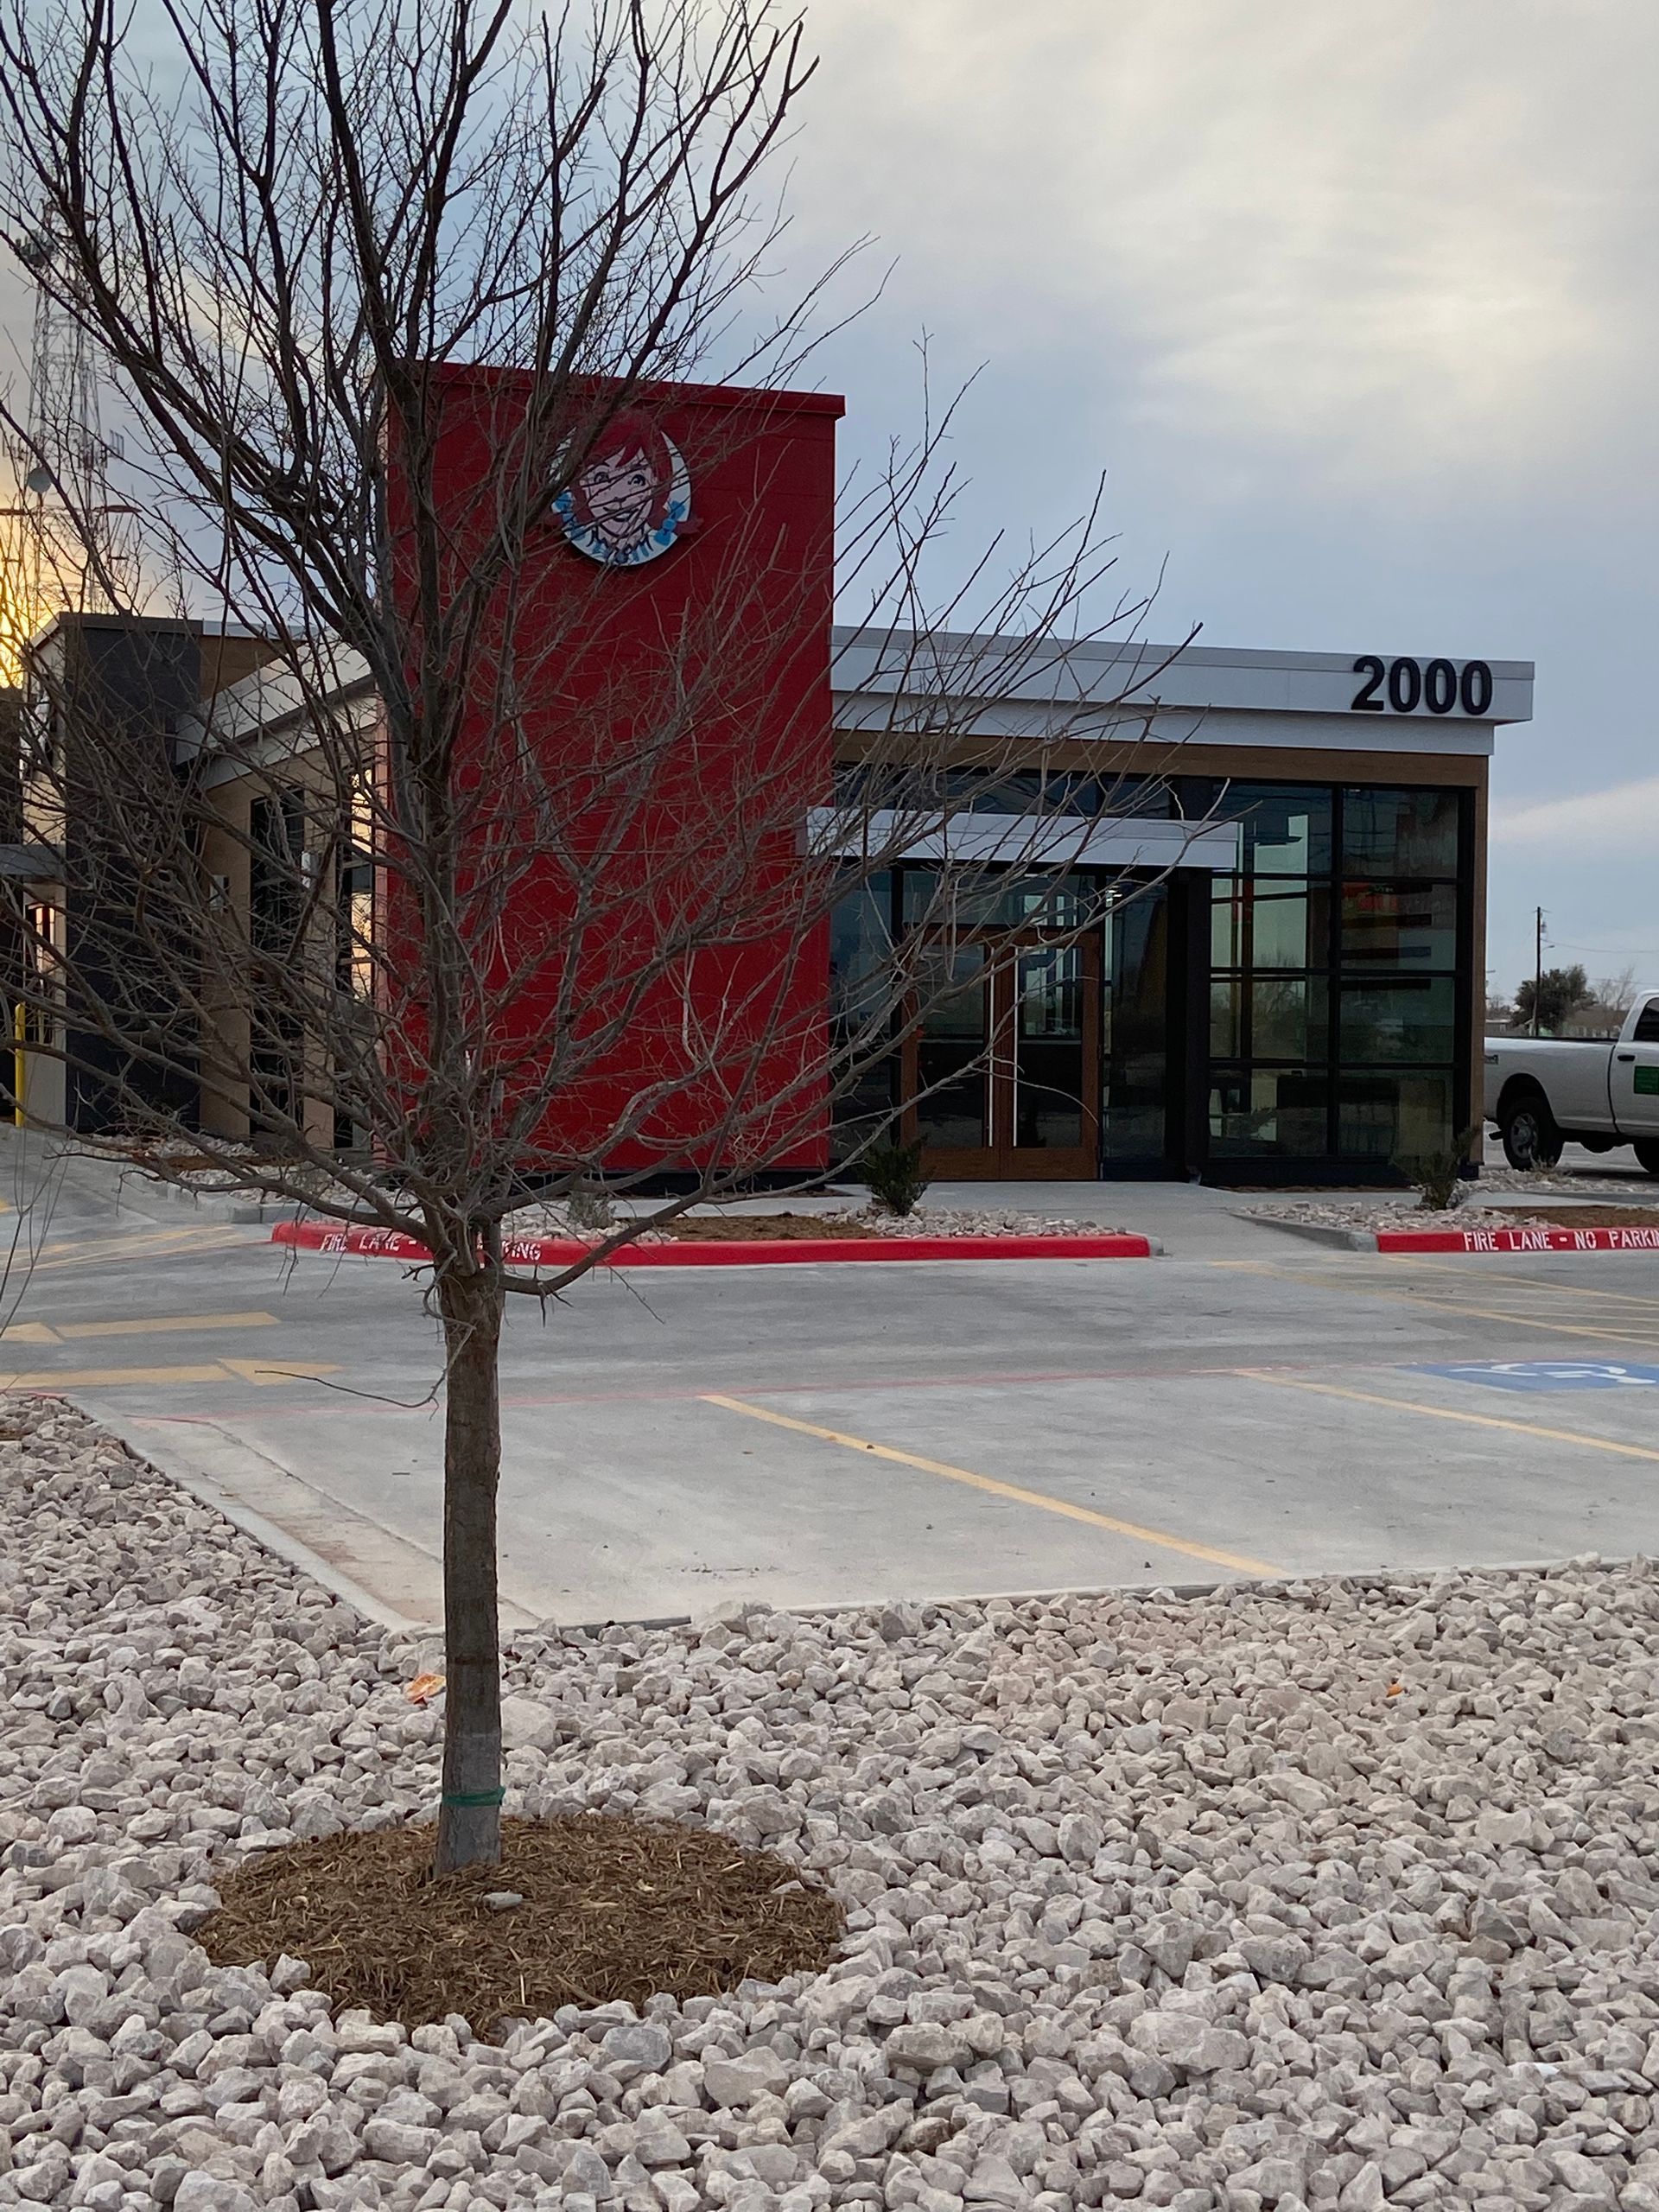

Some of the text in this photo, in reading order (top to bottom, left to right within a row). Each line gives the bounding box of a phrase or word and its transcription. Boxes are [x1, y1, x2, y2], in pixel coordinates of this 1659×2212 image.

[1351, 655, 1493, 716] 2000
[1464, 1232, 1499, 1251] FIRE
[1510, 1231, 1554, 1250] LANE
[1573, 1230, 1597, 1249] NO
